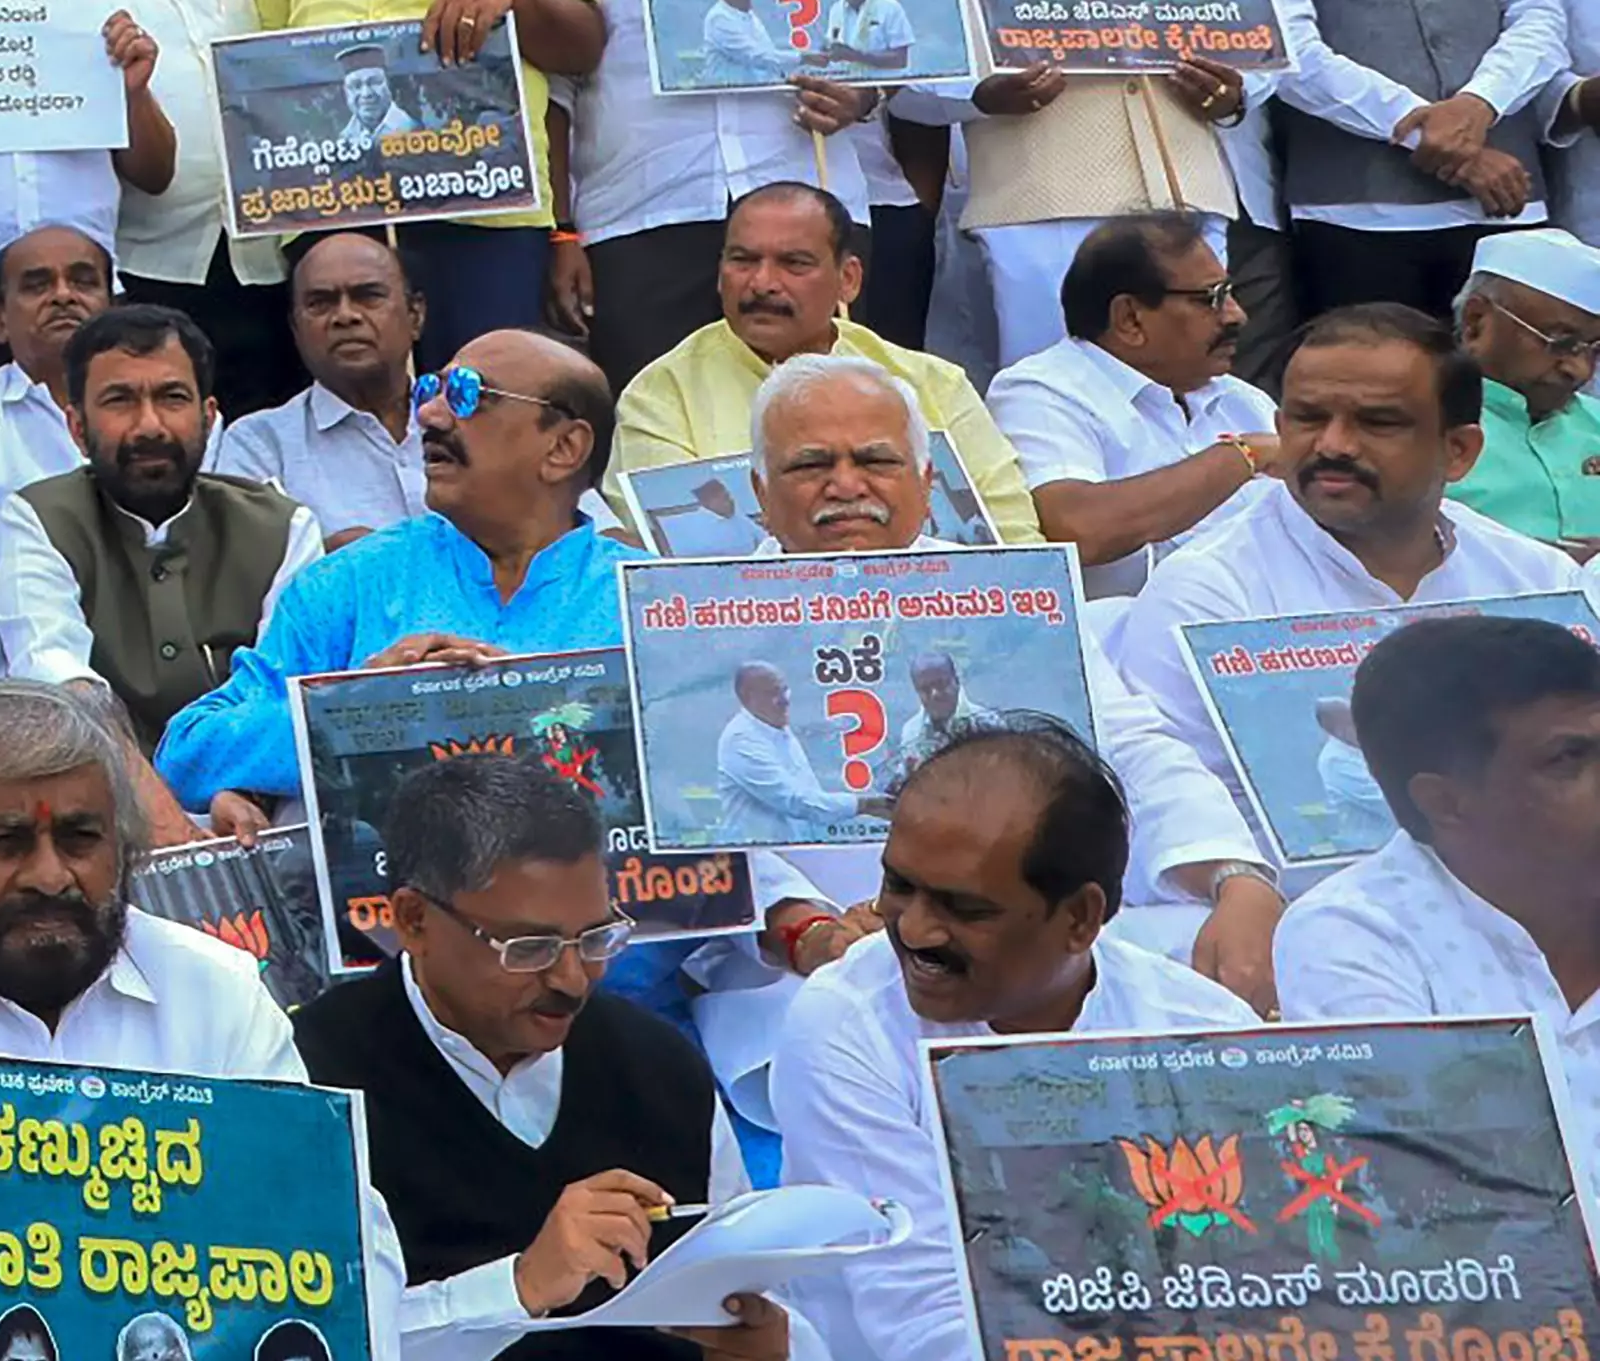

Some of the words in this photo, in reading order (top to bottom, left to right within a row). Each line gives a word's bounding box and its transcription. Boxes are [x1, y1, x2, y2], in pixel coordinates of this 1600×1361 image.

[1014, 1, 1068, 22] ಬಿಜೆಪಿ
[1072, 1, 1150, 22] ಜೆಡಿಎಸ್
[997, 22, 1161, 61] ರಾಜ್ಯಪಾಲರೇ
[1165, 22, 1274, 62] ಕೈಗೊಂಬೆ
[252, 136, 373, 175] ಗೆಹ್ಲೋಟ್
[380, 119, 501, 158] ಹಠಾವೋ
[240, 174, 399, 223] ಪ್ರಜಾಪ್ರಭುತ್ವ
[399, 162, 524, 201] ಬಚಾವೋ
[645, 603, 688, 630] ಗಣಿ
[693, 599, 802, 626] ಹಗರಣದ
[808, 590, 891, 622] ತನಿಖೆಗೆ
[898, 588, 1005, 618] ಅನುಮತಿ
[1010, 588, 1063, 623] ಇಲ್ಲ
[814, 633, 884, 685] ಏಕೆ
[1212, 644, 1254, 675] ಗಣಿ
[1257, 642, 1361, 673] ಹಗರಣದ
[825, 688, 888, 792] ?
[612, 856, 734, 912] ಗೊಂಬೆ
[1087, 1052, 1159, 1073] ಕರ್ನಾಟಕ
[1162, 1050, 1215, 1073] ಪ್ರದೇಶ
[1255, 1045, 1323, 1067] ಕಾಂಗ್ರೆಸ್
[1326, 1042, 1373, 1061] ಸಮಿತಿ
[28, 1074, 76, 1097] ಪ್ರದೇಶ
[110, 1079, 170, 1104] ಕಾಂಗ್ರೆಸ್
[172, 1086, 213, 1107] ಸಮಿತಿ
[77, 1234, 334, 1332] ರಾಜ್ಯಪಾಲ
[1041, 1264, 1151, 1313] ಬಿಜೆಪಿ
[1162, 1260, 1321, 1308] ಜೆಡಿಎಸ್
